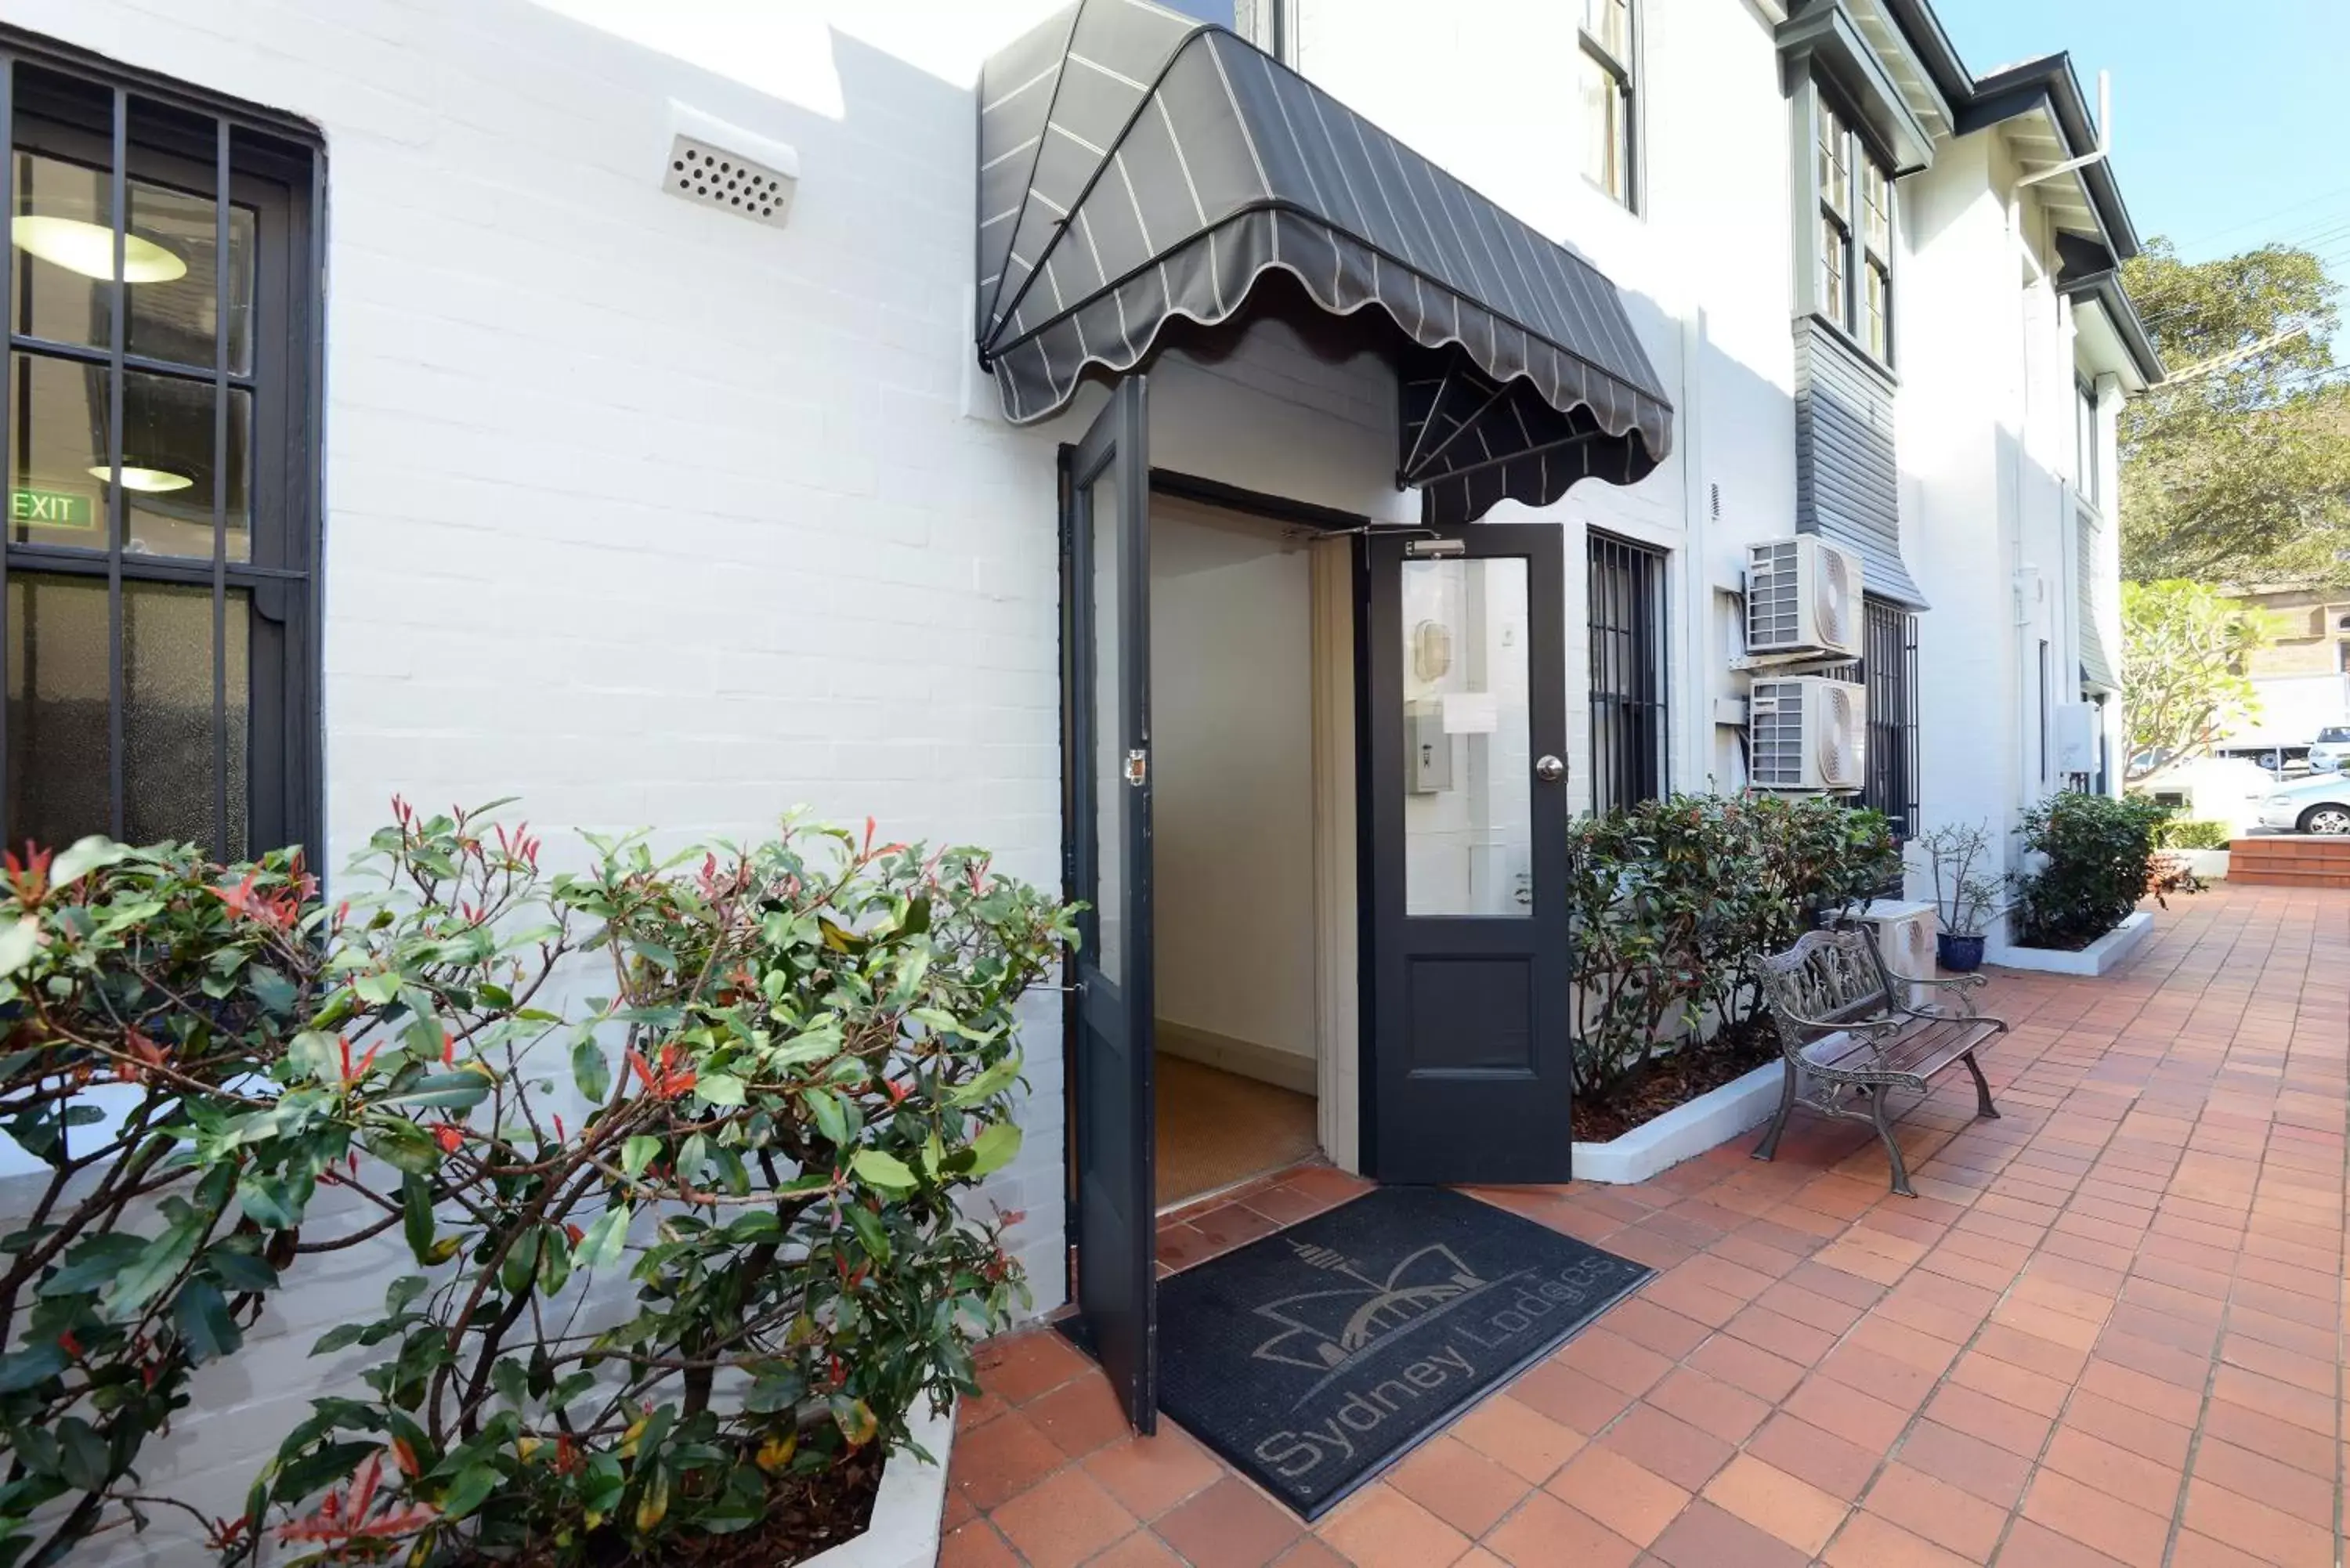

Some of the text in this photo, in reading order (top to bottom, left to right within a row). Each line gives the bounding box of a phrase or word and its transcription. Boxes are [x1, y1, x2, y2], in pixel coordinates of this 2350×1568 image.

[12, 493, 74, 521] EXIT
[1254, 1255, 1616, 1476] Sydney Lodges
